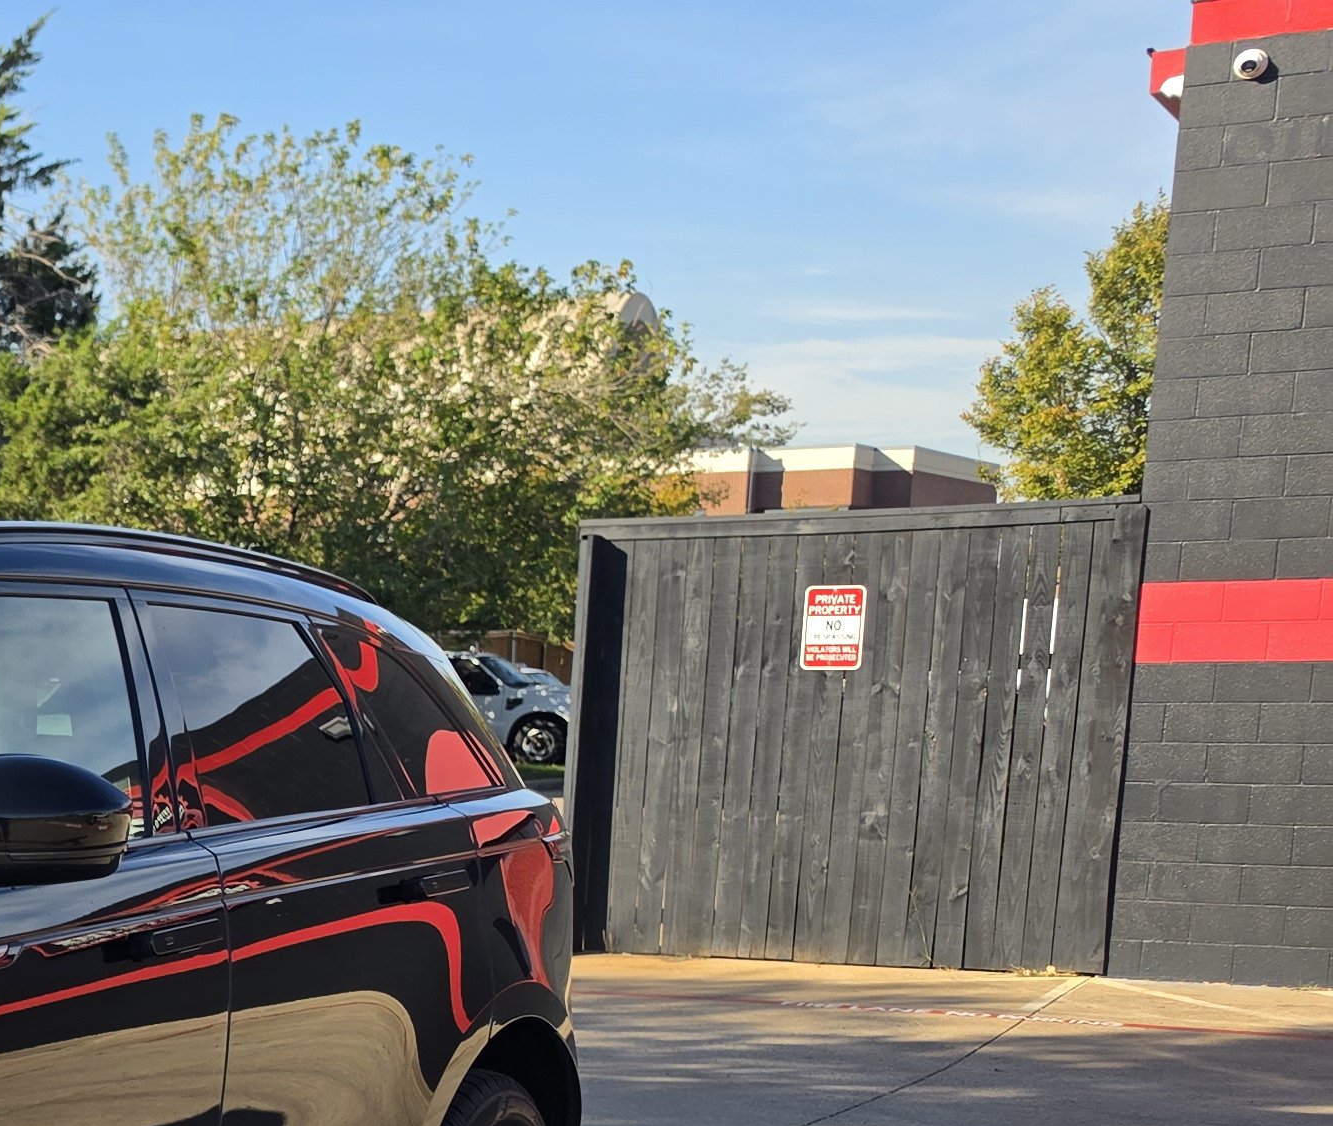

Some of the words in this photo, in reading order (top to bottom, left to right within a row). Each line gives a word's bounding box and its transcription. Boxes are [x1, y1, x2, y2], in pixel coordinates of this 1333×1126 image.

[814, 593, 857, 605] PRIVATE
[808, 604, 862, 616] PROPERTY
[825, 619, 842, 631] NO
